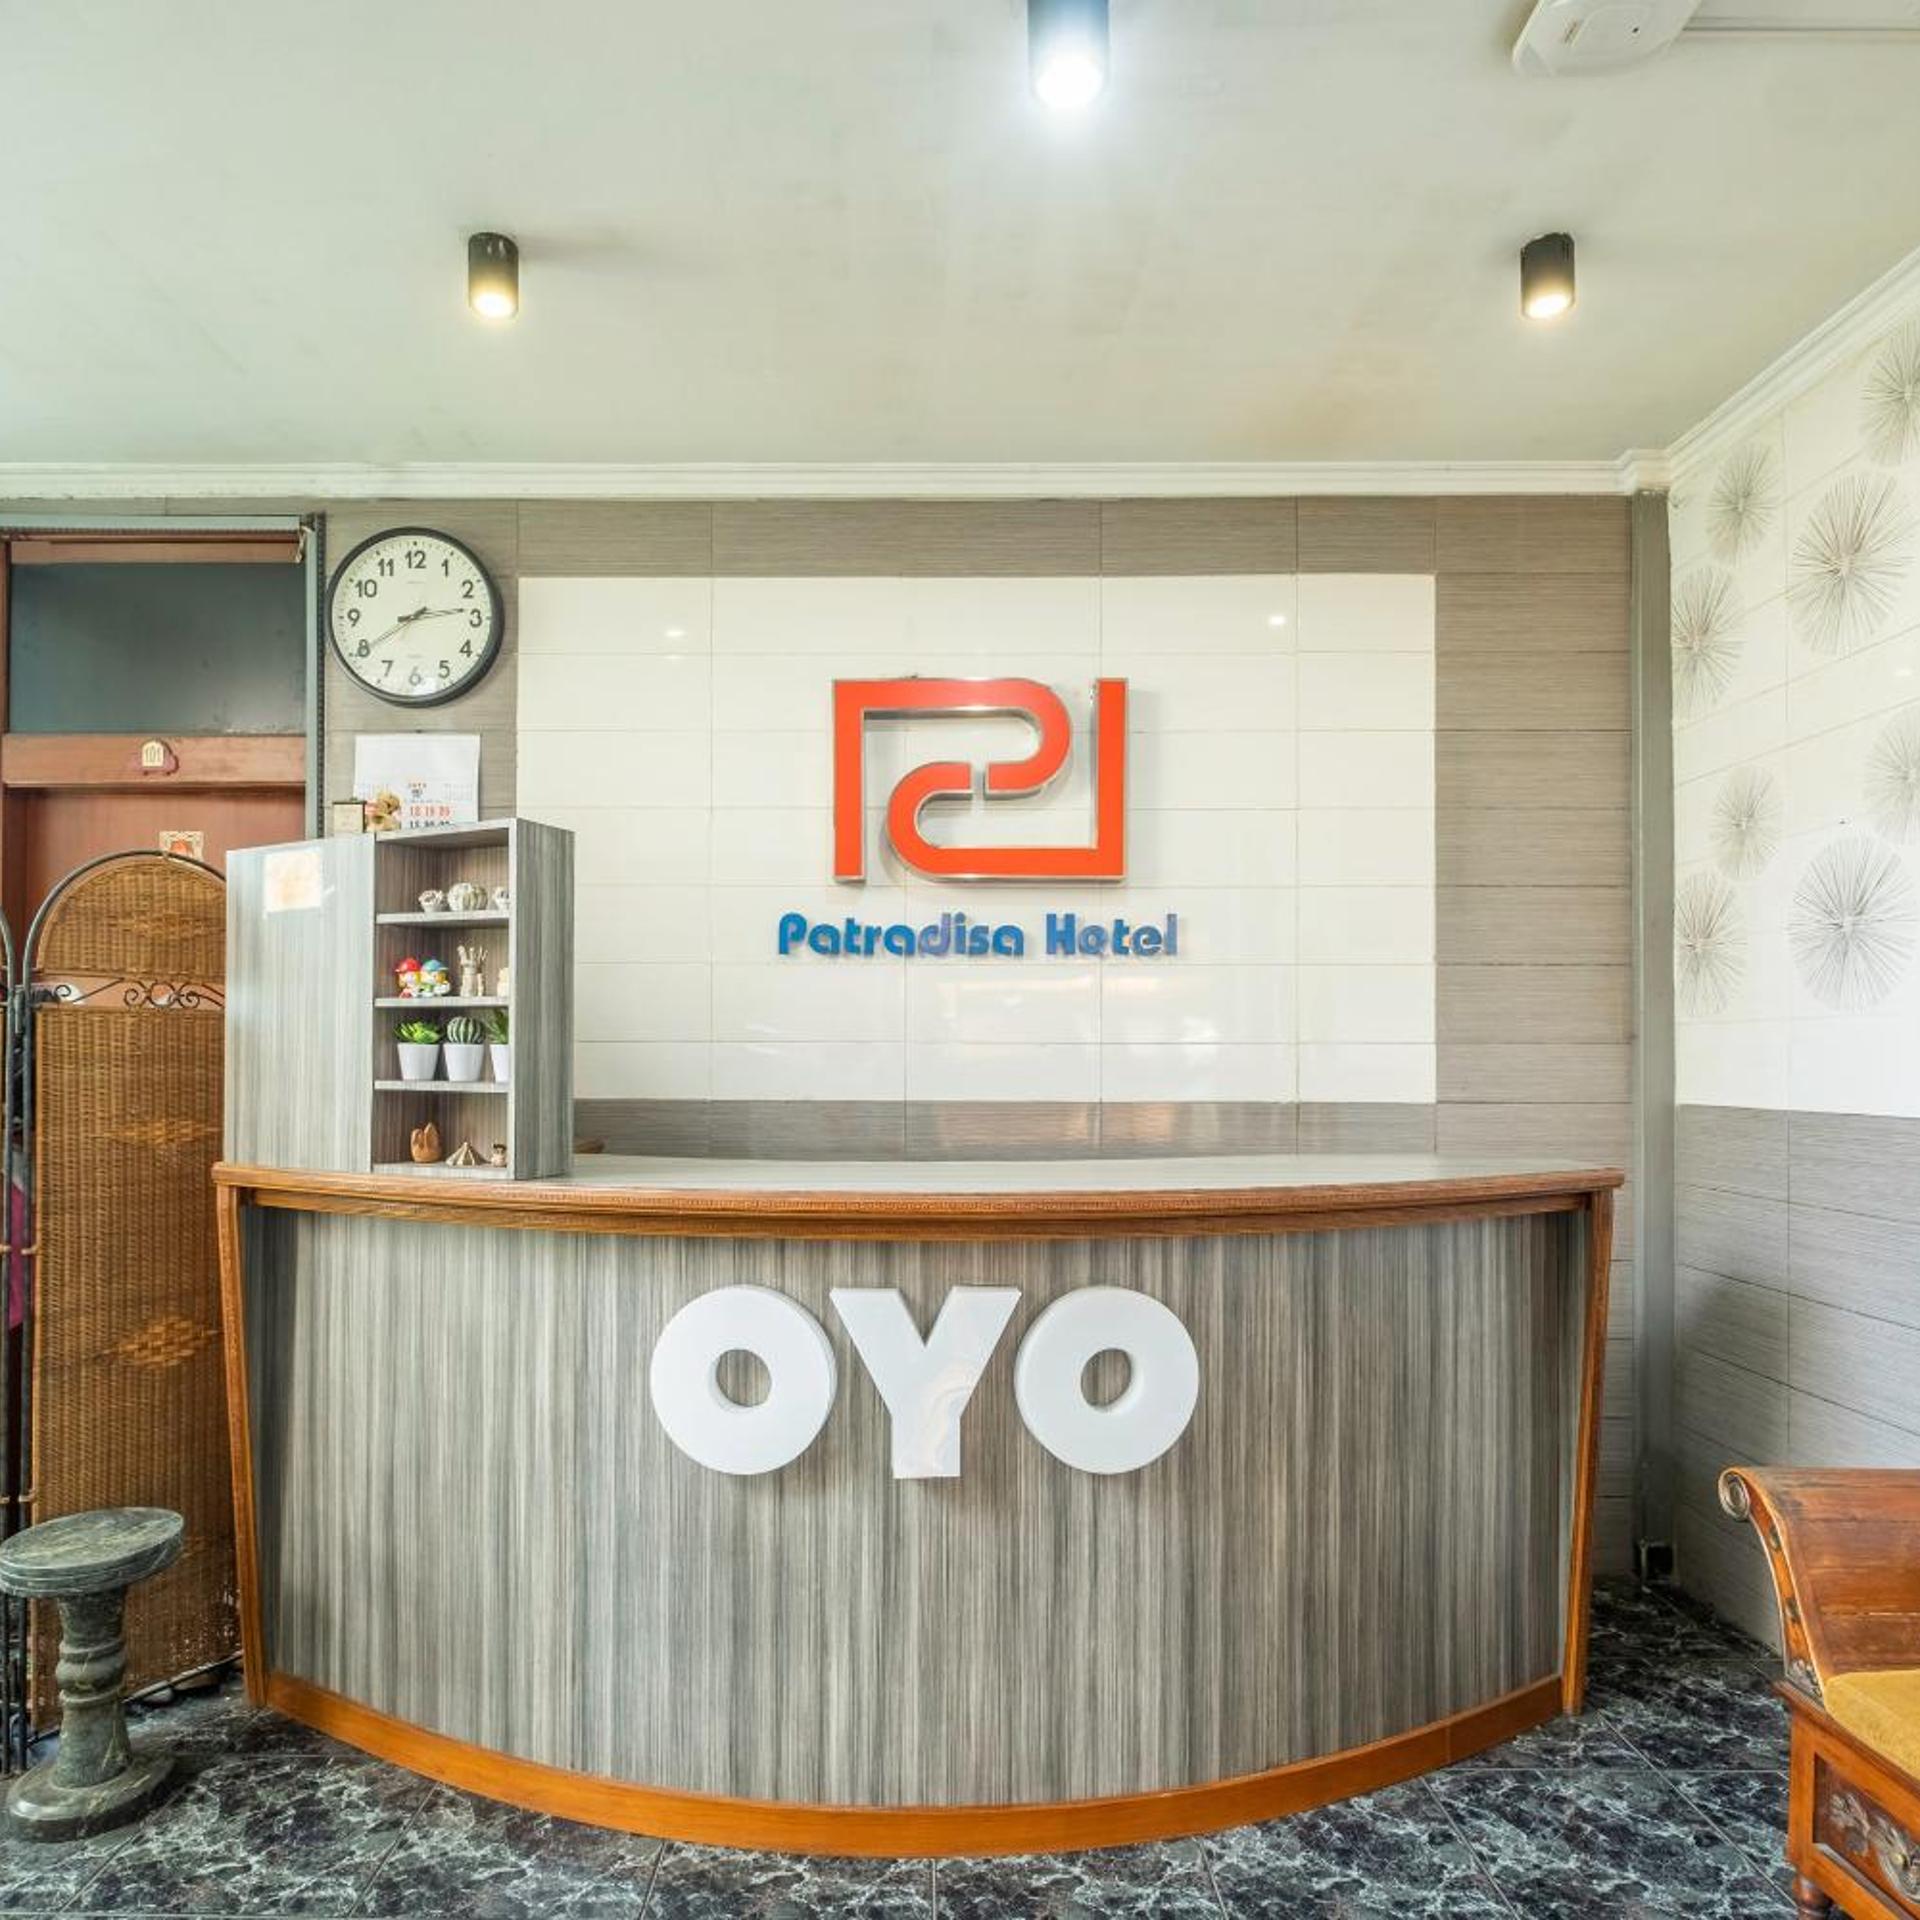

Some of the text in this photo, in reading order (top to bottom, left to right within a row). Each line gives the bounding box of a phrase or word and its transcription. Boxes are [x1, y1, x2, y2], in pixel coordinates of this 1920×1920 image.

[377, 558, 395, 577] 11
[404, 550, 427, 569] 12
[441, 559, 449, 577] 1
[354, 579, 378, 598] 10
[461, 580, 474, 599] 2
[347, 608, 360, 627] 9
[469, 608, 483, 627] 3
[357, 639, 371, 657] 8
[459, 639, 473, 658] 4
[381, 659, 394, 677] 7
[408, 666, 422, 686] 6
[438, 660, 451, 678] 5
[778, 912, 1178, 956] Patradisa Hotel
[650, 1284, 1200, 1479] OYO
